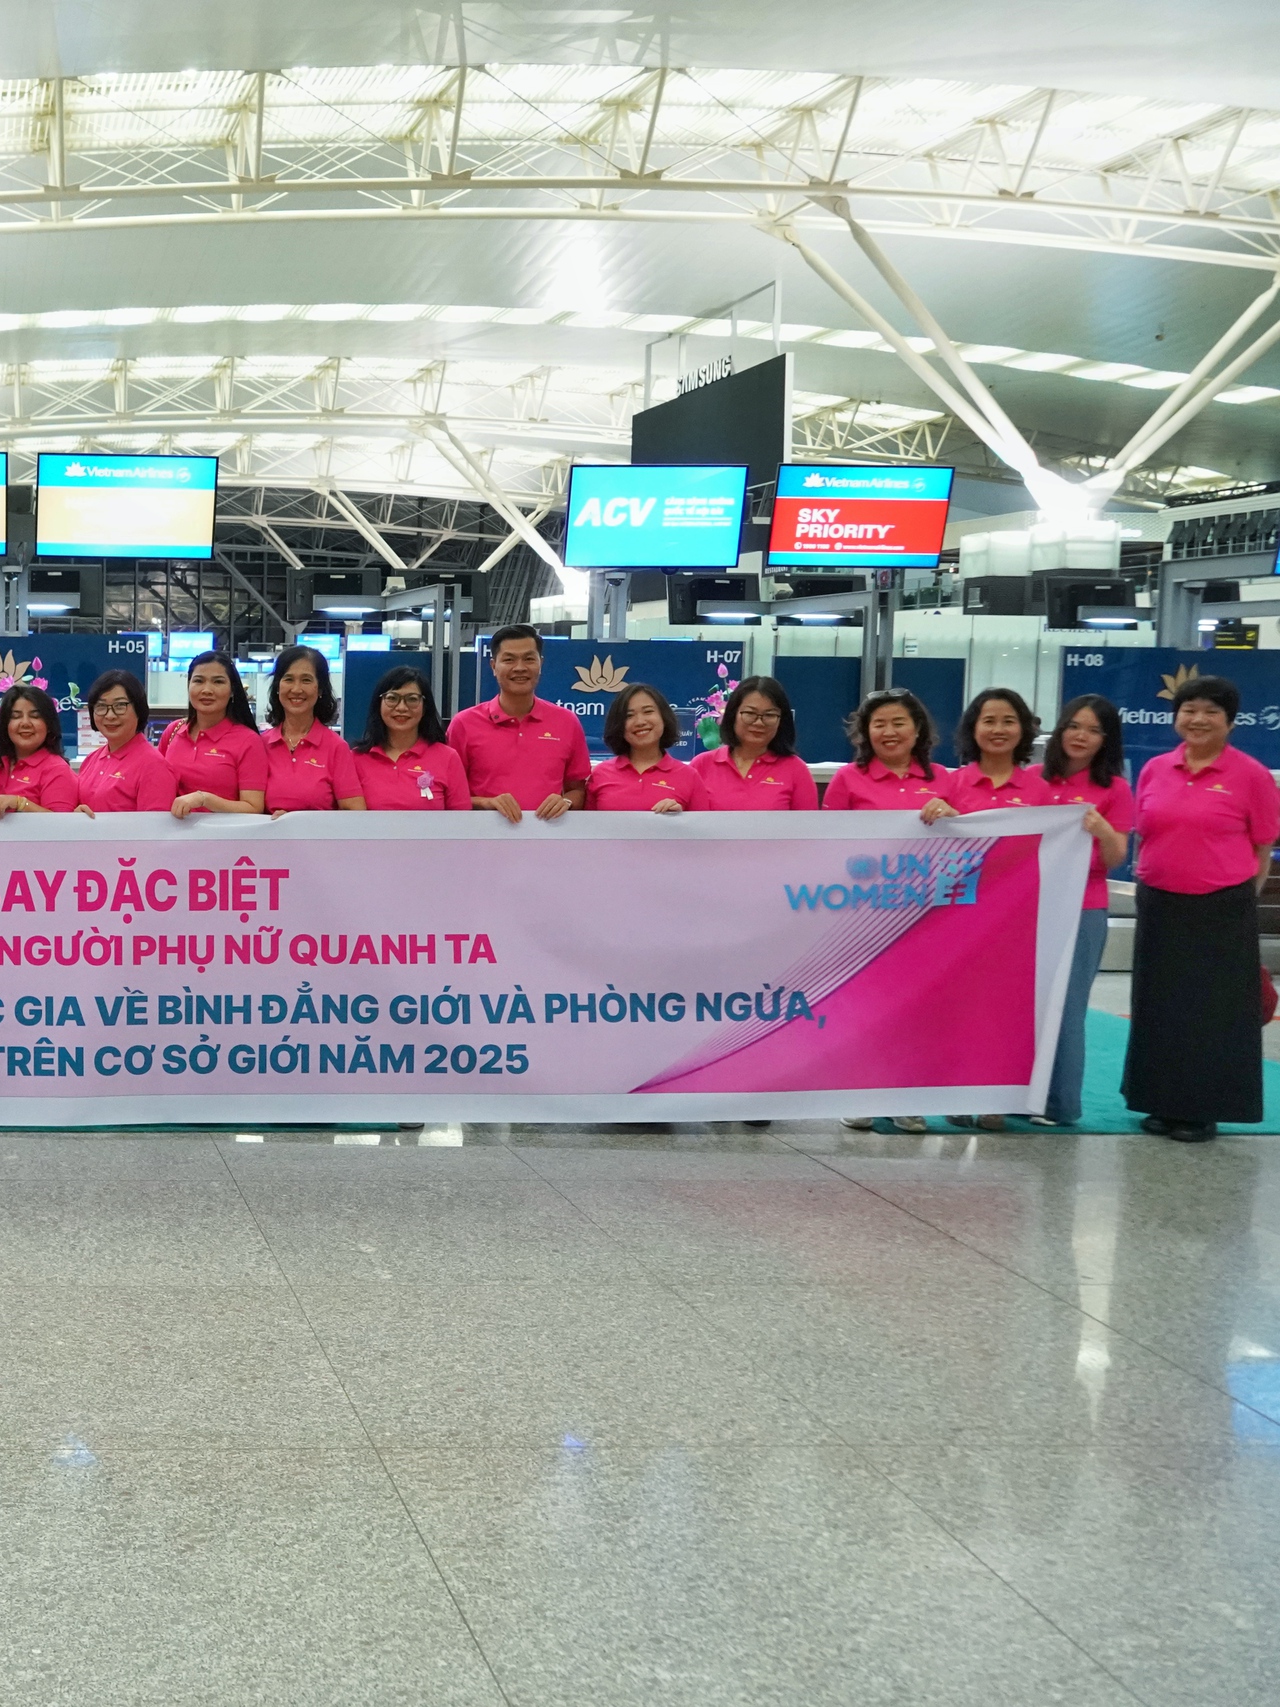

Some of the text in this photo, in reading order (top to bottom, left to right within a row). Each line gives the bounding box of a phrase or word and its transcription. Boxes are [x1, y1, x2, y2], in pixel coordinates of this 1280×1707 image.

[573, 497, 657, 527] ACV
[797, 508, 841, 524] SKY
[795, 523, 889, 539] PRIORITY
[107, 640, 146, 655] H-05
[706, 650, 742, 663] H-07
[1066, 653, 1104, 667] H-08
[555, 699, 605, 716] tnam
[880, 854, 930, 880] UN
[73, 857, 178, 924] ĐẶC
[188, 856, 290, 923] BIỆT
[784, 883, 928, 911] WOMEN
[132, 934, 215, 974] PHỤ
[225, 926, 283, 966] NỮ
[289, 933, 436, 968] QUANH
[445, 933, 498, 965] TA
[15, 996, 87, 1028] GIA
[95, 986, 150, 1027] VỀ
[158, 986, 252, 1027] BÌNH
[258, 981, 380, 1026] ĐẲNG
[389, 986, 471, 1026] GIỚI
[480, 984, 536, 1025] VÀ
[545, 984, 687, 1025] PHÒNG
[695, 983, 827, 1029] NGỪA,
[94, 1044, 157, 1078] CƠ
[162, 1034, 222, 1077] SỞ
[228, 1035, 311, 1076] GIỚI
[320, 1035, 415, 1075] NĂM
[424, 1044, 529, 1076] 2025
